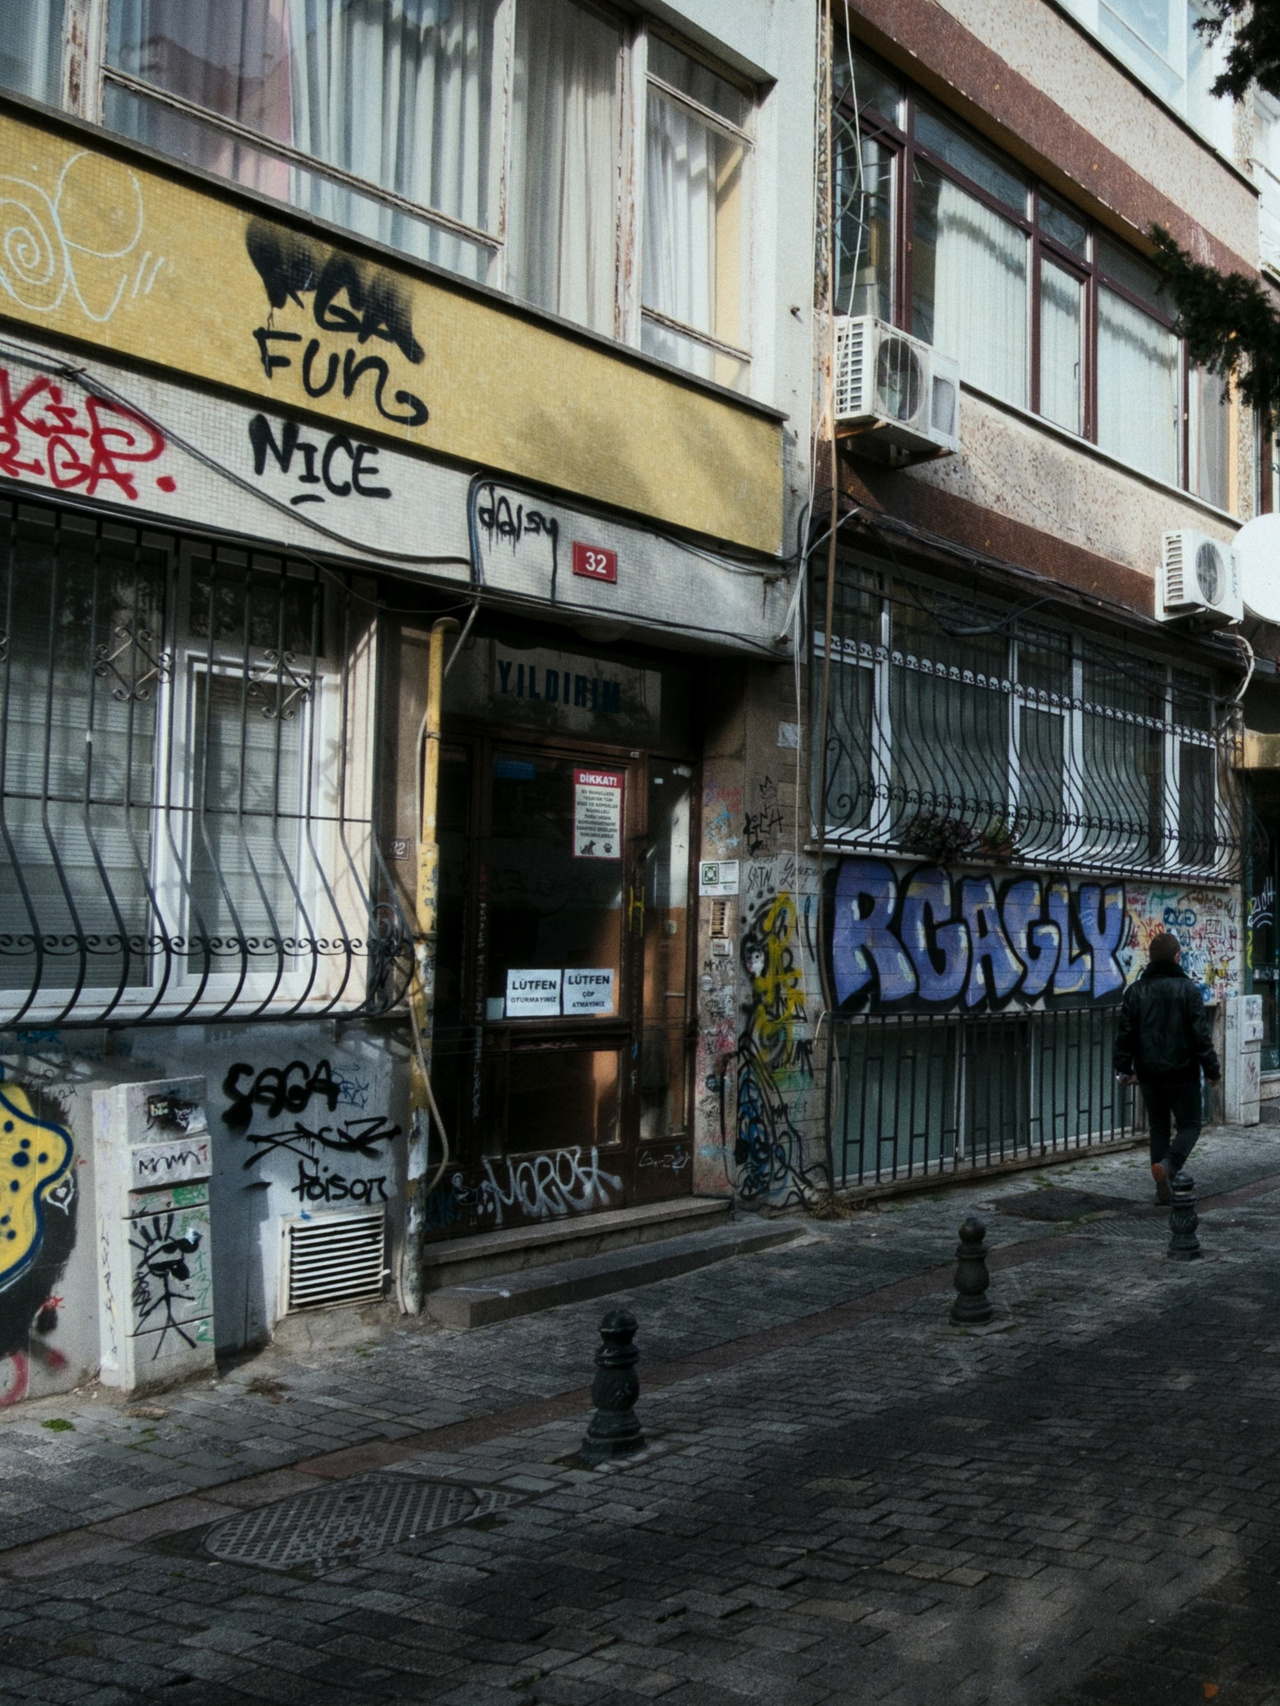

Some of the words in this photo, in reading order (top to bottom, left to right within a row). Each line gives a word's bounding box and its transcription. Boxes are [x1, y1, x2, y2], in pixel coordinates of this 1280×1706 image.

[585, 551, 607, 573] 32
[497, 659, 622, 715] YILDIRIM
[580, 773, 618, 786] DİKKAT!
[511, 978, 557, 990] LÜTFEN
[567, 974, 611, 985] LÜTFEN
[582, 990, 595, 998] ÇÖP
